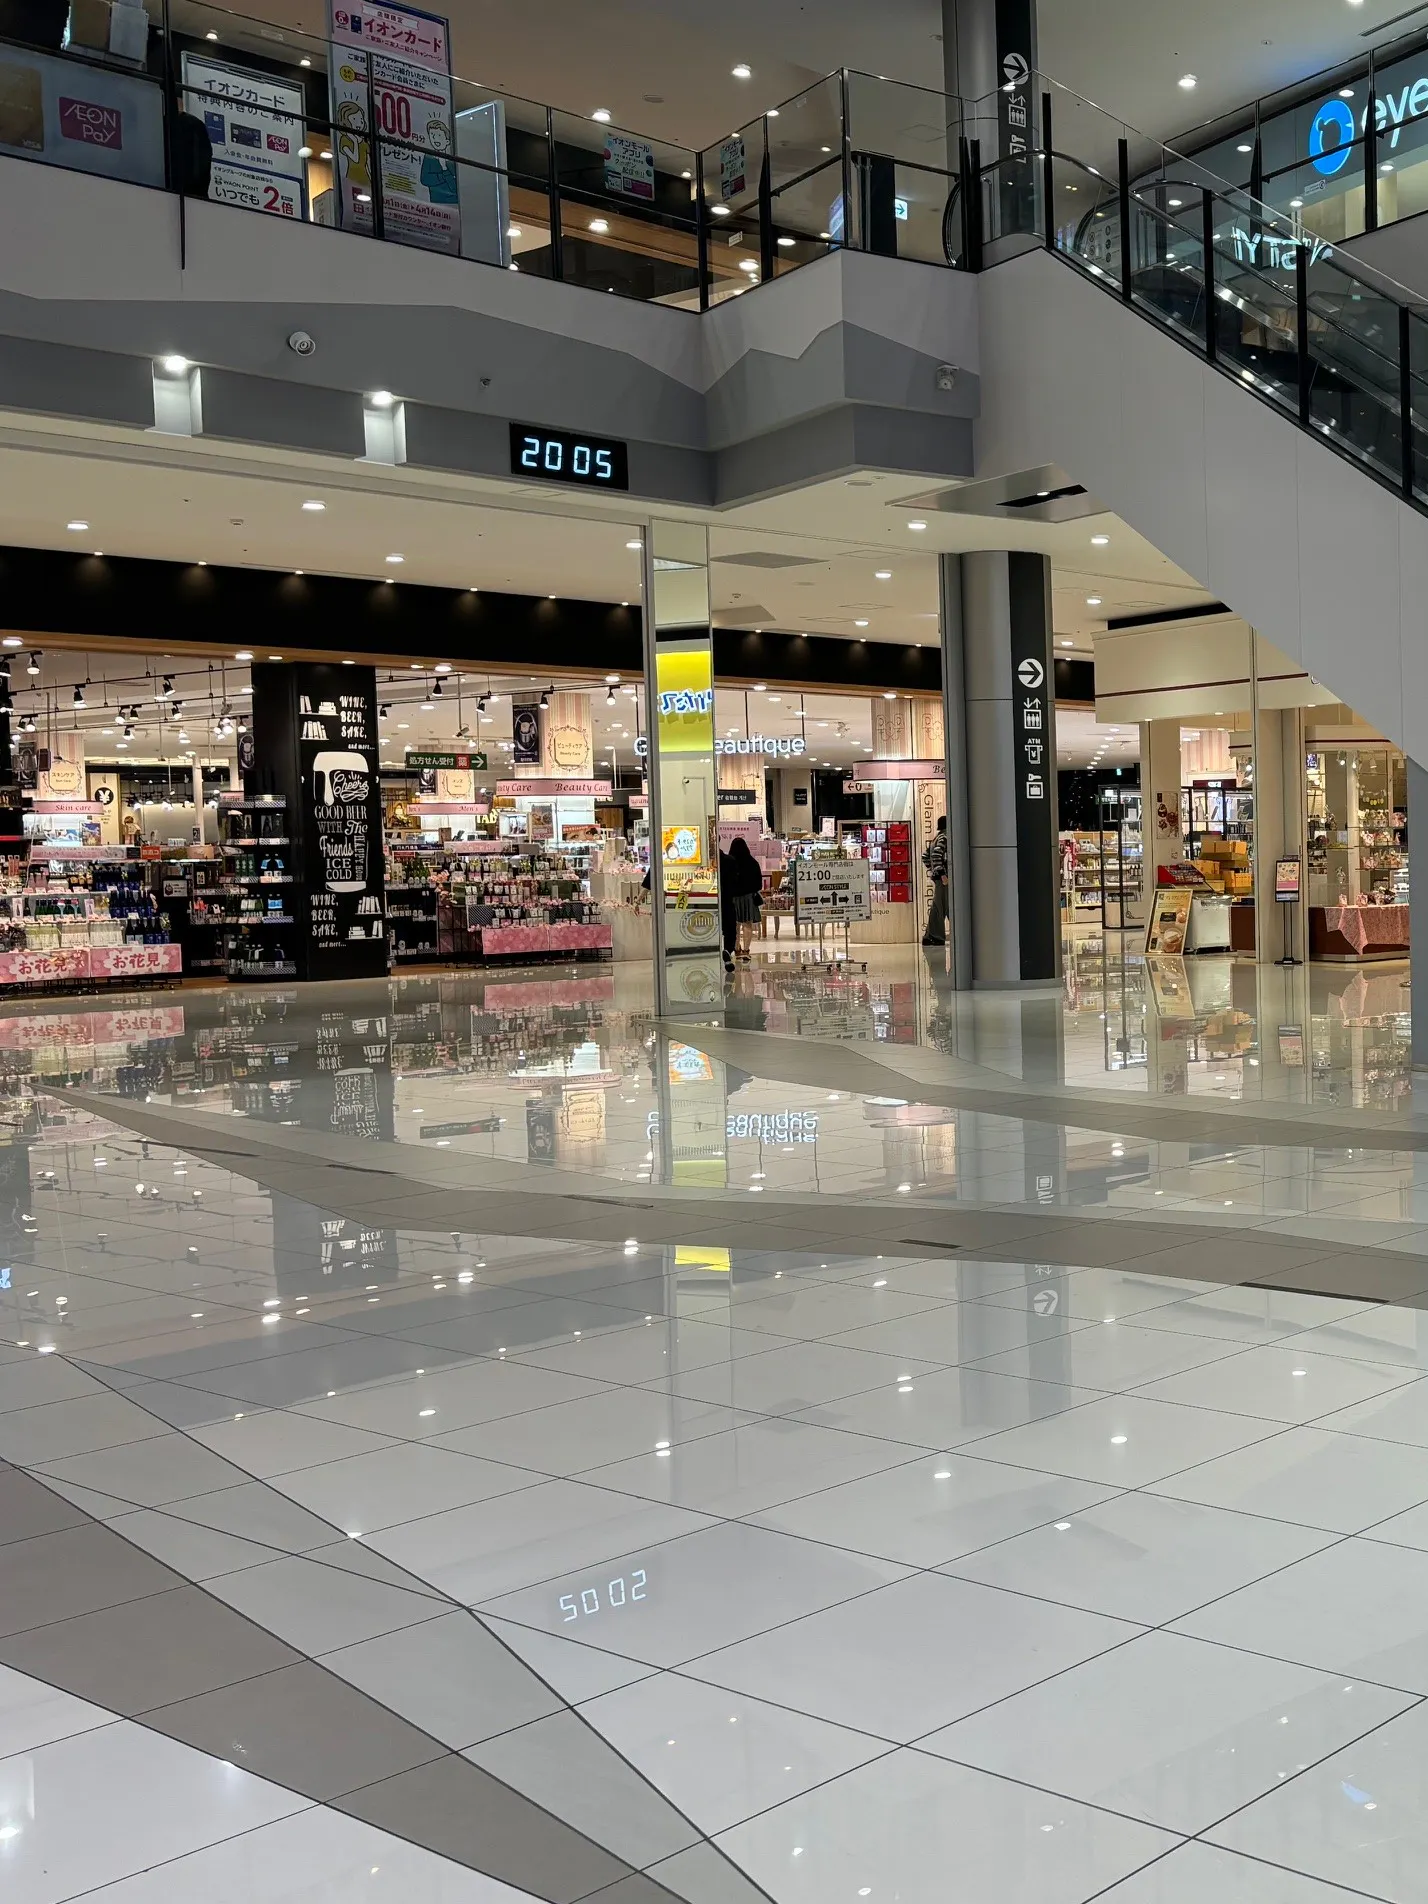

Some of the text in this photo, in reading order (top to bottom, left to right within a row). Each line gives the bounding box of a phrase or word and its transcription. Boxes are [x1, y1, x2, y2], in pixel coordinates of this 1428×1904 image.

[364, 18, 443, 53] イオンカード
[204, 79, 286, 108] イオンカード
[82, 123, 116, 144] Pay
[383, 146, 422, 164] レゼント!
[215, 185, 294, 216] いつでも 2倍
[340, 710, 366, 724] BEER,
[714, 734, 805, 758] eautique
[409, 756, 455, 766] 処方せん受付
[332, 771, 370, 802] Cheers
[511, 783, 532, 792] Care
[554, 782, 593, 793] Beauty
[314, 804, 368, 820] GOOD BEER
[923, 794, 934, 834] Glam
[317, 819, 369, 836] WITH The
[319, 835, 354, 858] Friends
[326, 858, 352, 869] ICE
[325, 869, 352, 880] COLD
[798, 869, 831, 881] 21:00
[18, 957, 67, 975] お花見
[112, 952, 161, 969] お花見
